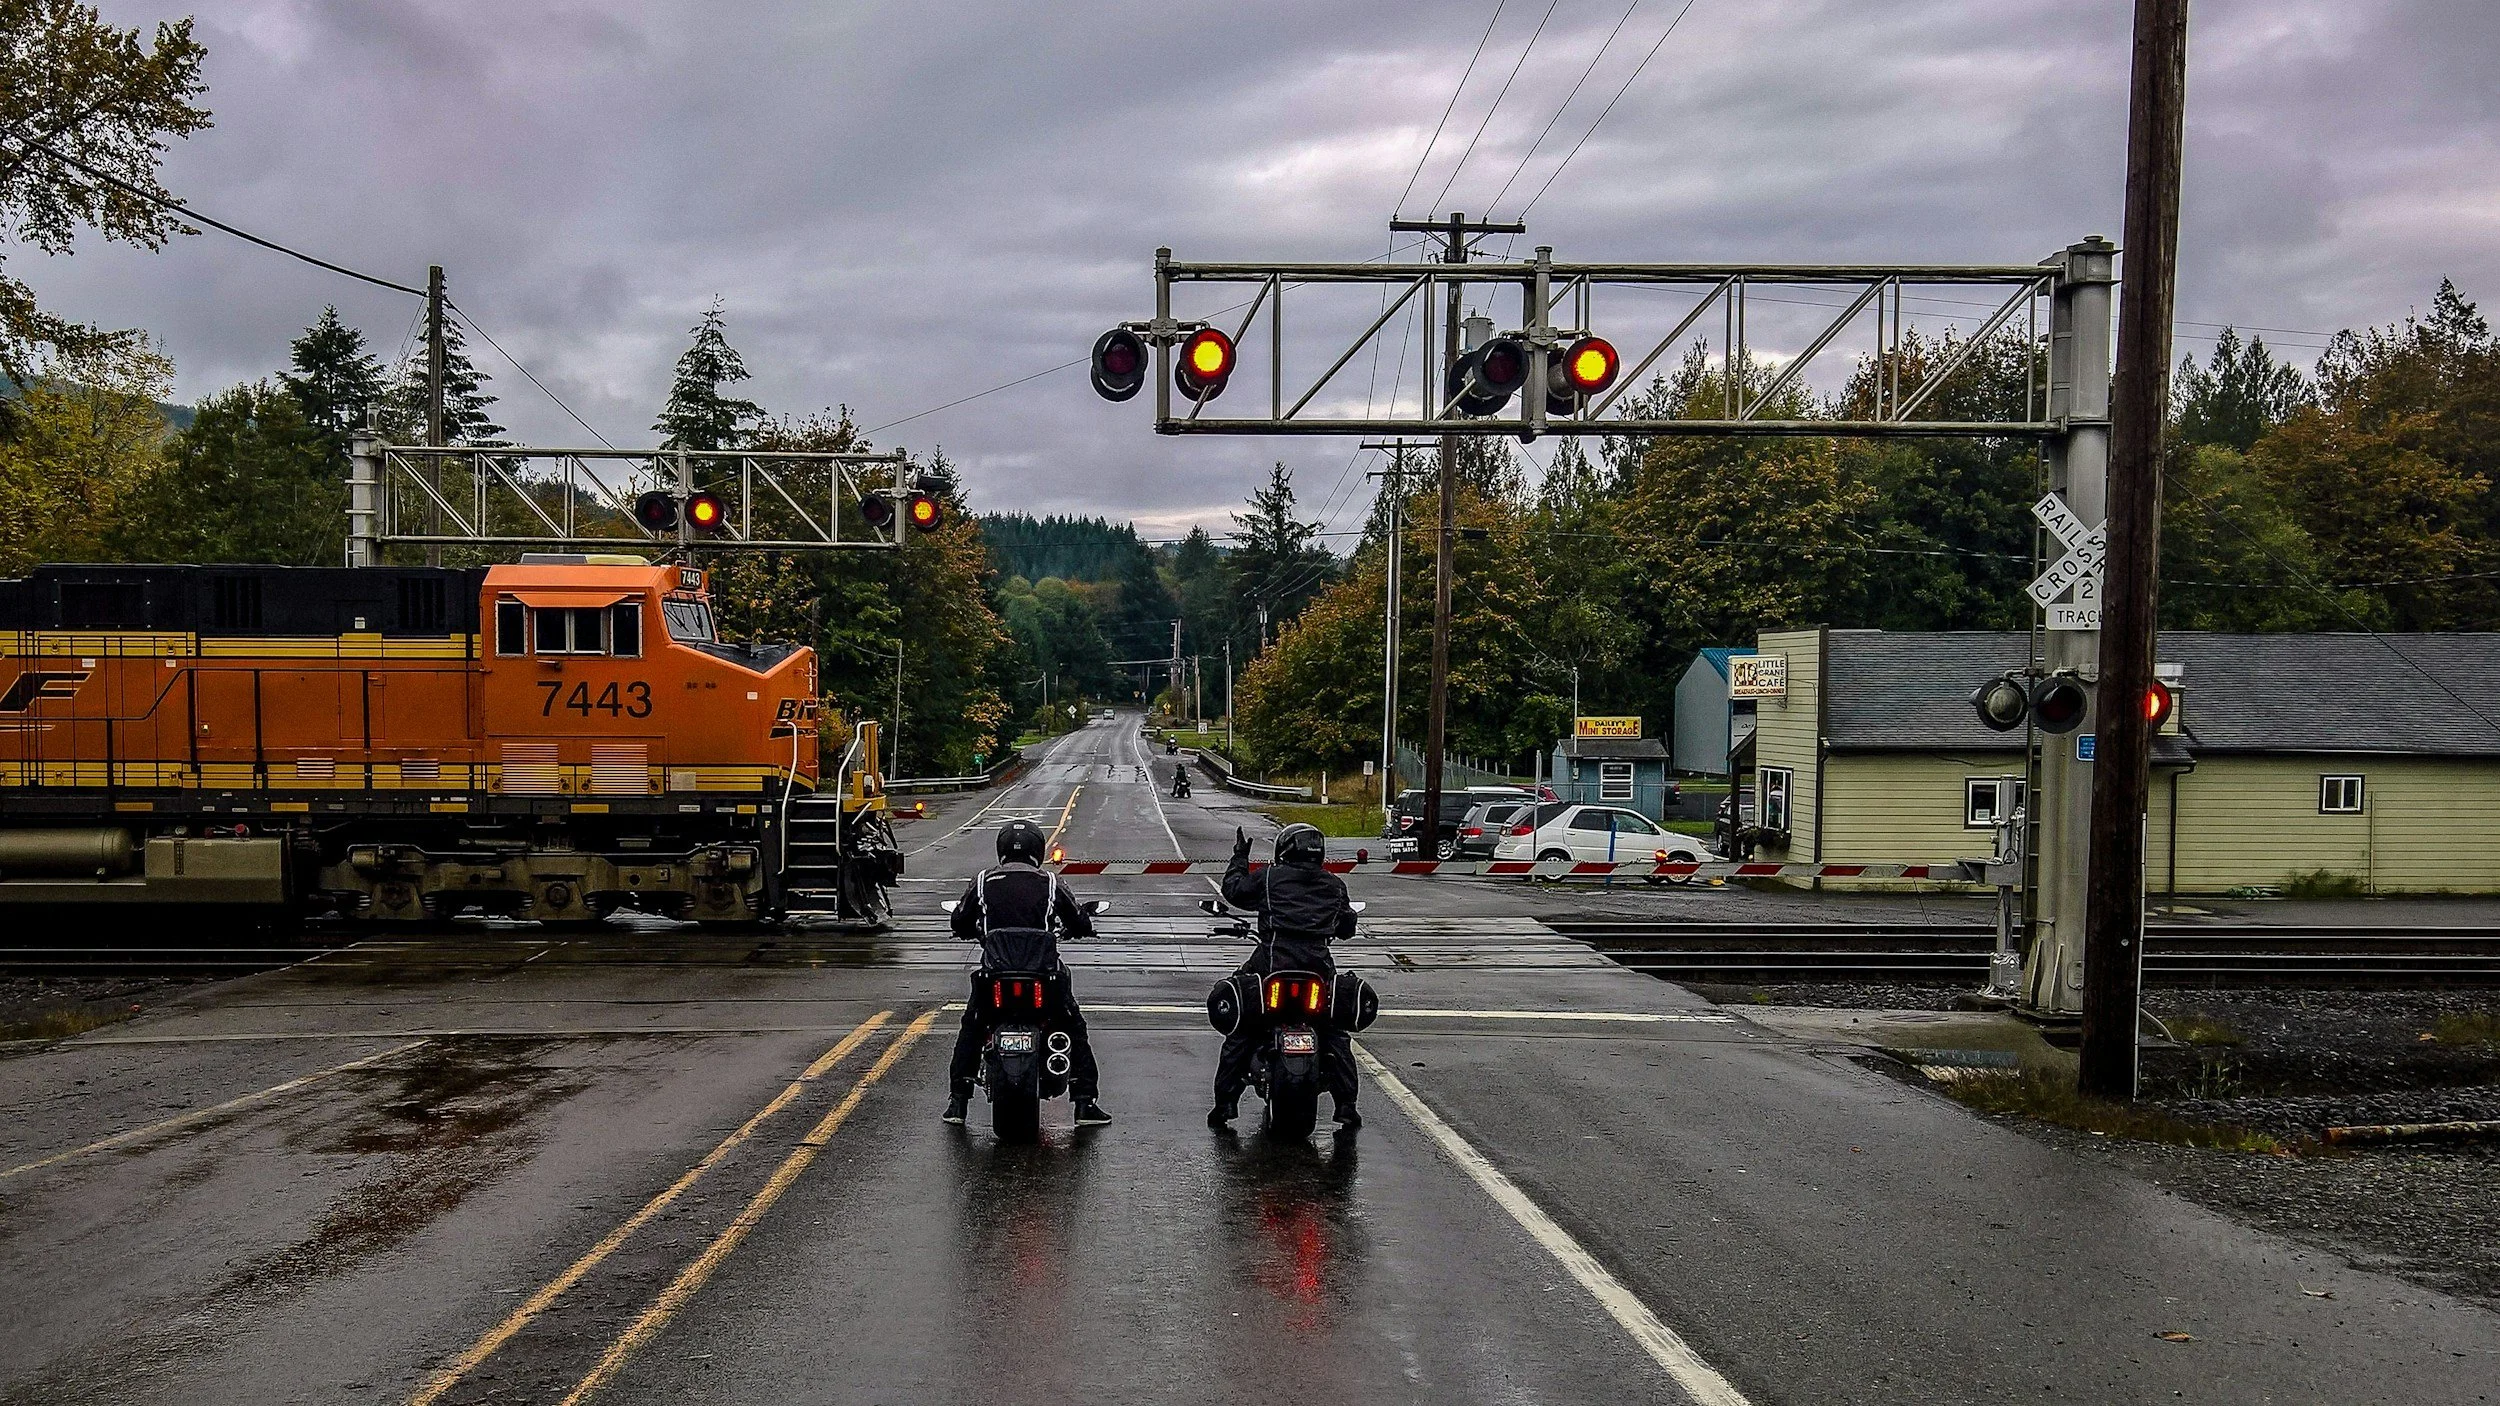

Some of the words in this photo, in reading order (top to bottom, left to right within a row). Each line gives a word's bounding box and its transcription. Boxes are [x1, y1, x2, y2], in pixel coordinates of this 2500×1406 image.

[2038, 498, 2082, 548] RAIL
[2034, 530, 2107, 601] CROSS
[681, 570, 701, 587] 7443
[2081, 580, 2094, 600] 2
[1758, 659, 1785, 668] LITTLE
[536, 680, 653, 719] 7443
[1579, 720, 1599, 735] MINI
[1602, 720, 1638, 735] STORAGE
